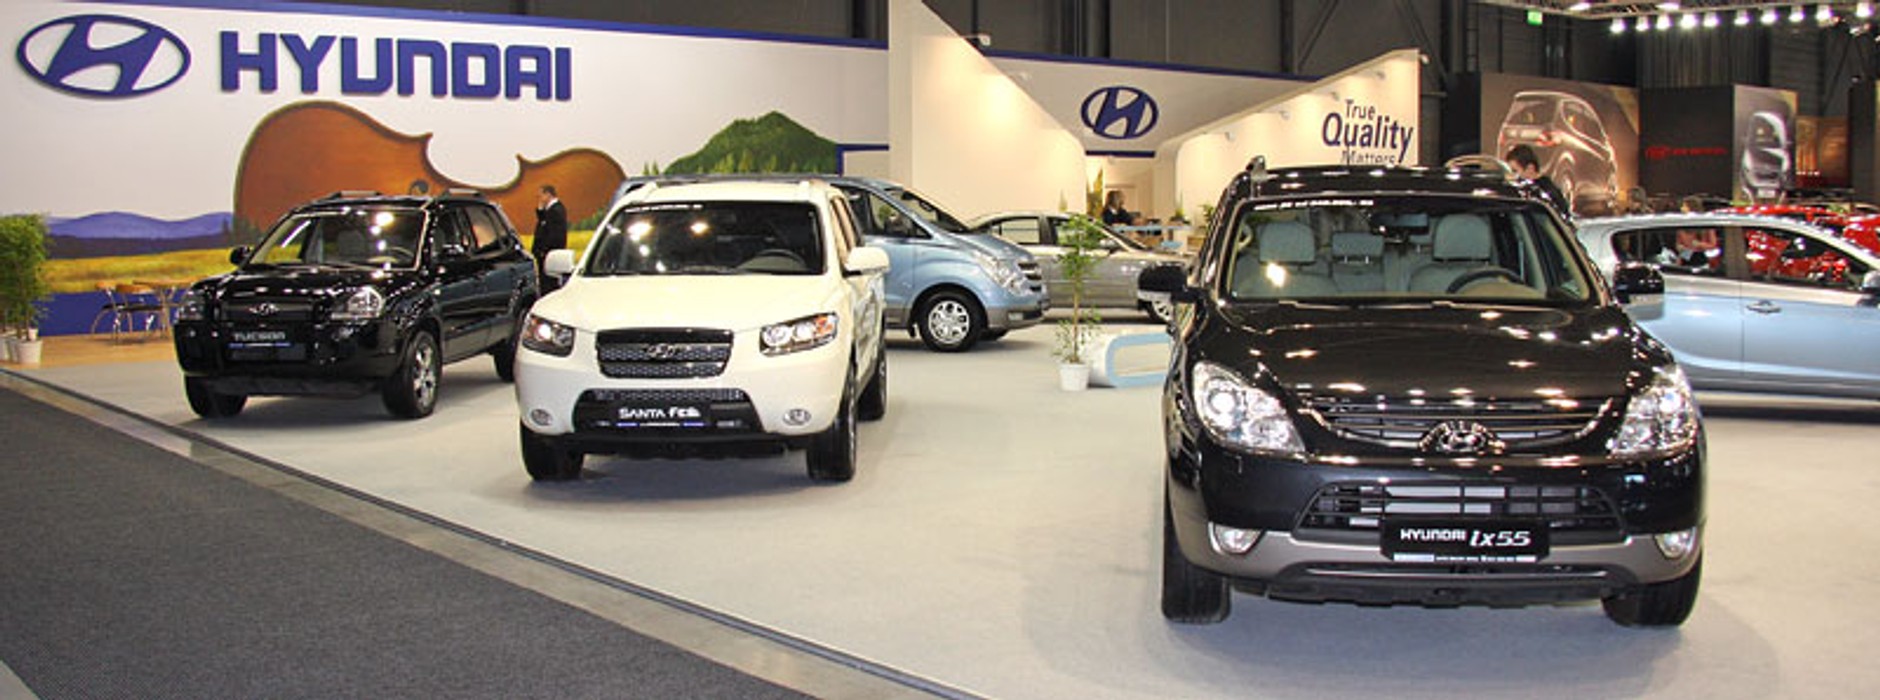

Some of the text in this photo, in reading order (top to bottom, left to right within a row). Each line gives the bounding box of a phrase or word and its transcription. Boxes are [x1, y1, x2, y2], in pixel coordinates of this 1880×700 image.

[219, 30, 572, 101] HYUNDAI
[1345, 98, 1376, 120] True
[1322, 111, 1414, 164] Quality
[619, 407, 666, 419] SANTA
[1400, 528, 1466, 541] HYUNDAI
